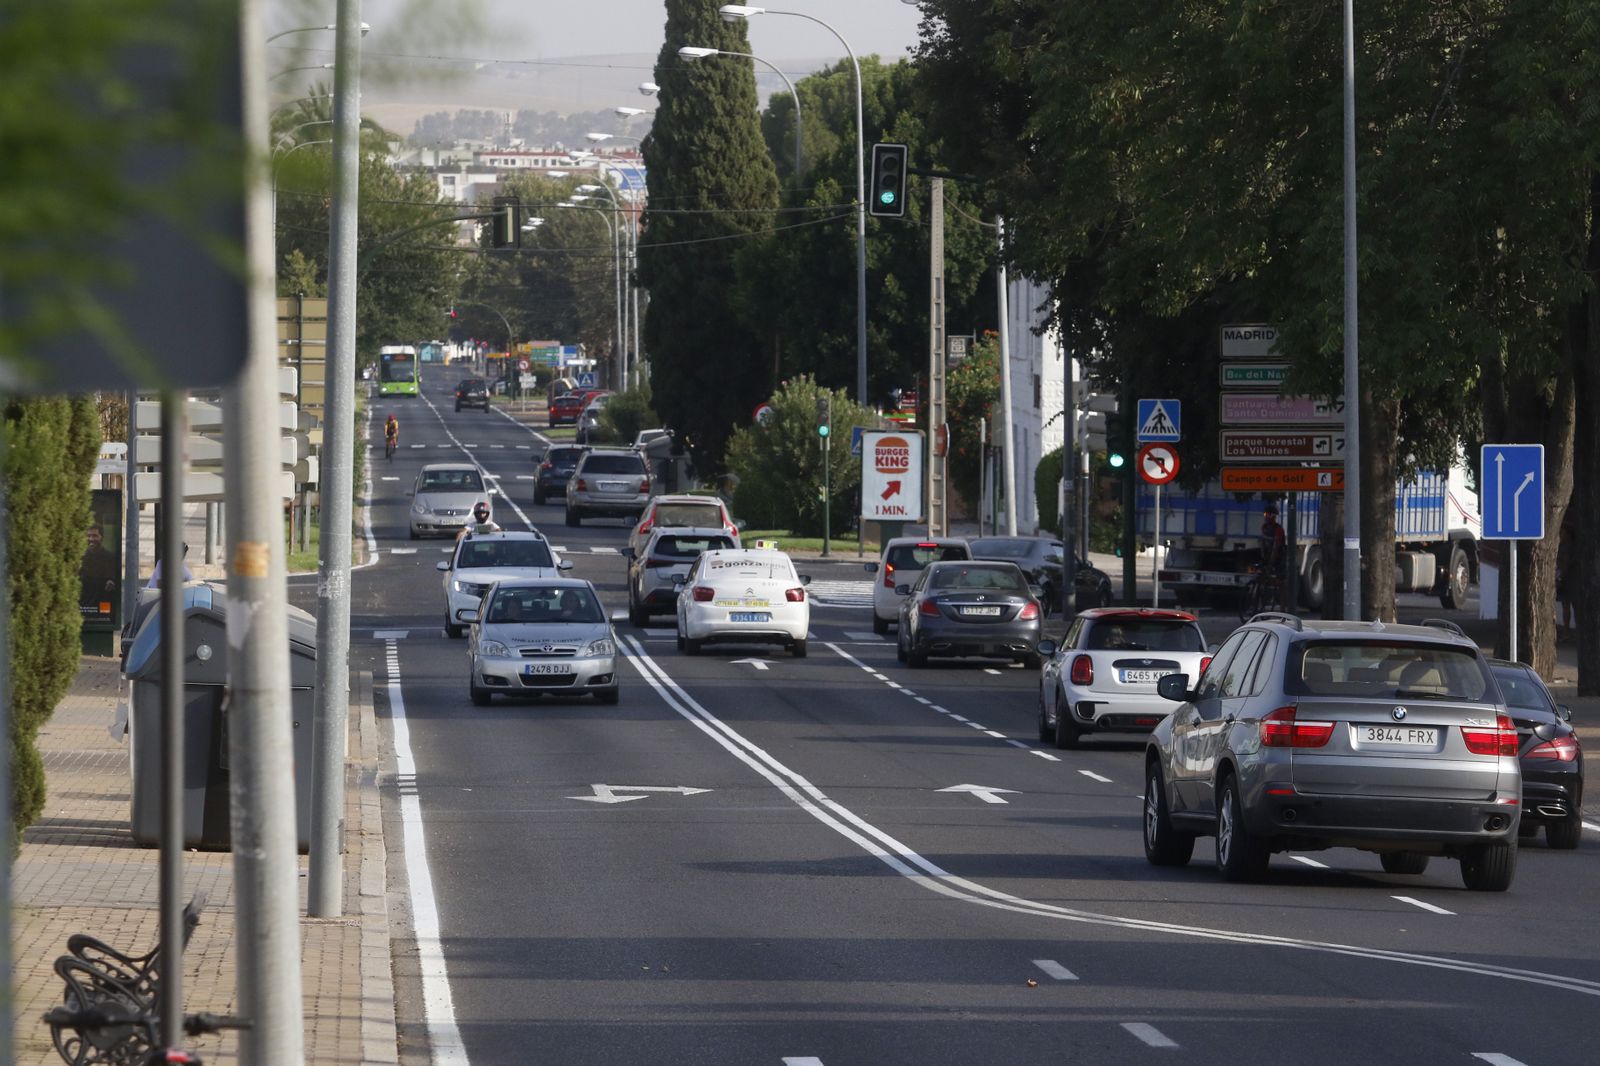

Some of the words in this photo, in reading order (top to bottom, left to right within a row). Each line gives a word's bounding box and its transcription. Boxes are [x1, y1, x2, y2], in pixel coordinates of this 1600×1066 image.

[1224, 330, 1275, 341] MADRID
[1245, 370, 1264, 380] del
[1227, 409, 1258, 418] Santo
[1260, 409, 1308, 419] Domingo
[1226, 438, 1263, 447] parque
[1266, 437, 1307, 446] forestal
[875, 448, 909, 456] BURGER
[1226, 447, 1246, 456] Los
[1249, 447, 1290, 456] Villares
[875, 456, 909, 467] KING
[1227, 474, 1261, 484] Campo
[1265, 474, 1278, 484] de
[1282, 474, 1306, 484] Golf
[881, 505, 908, 516] MIN.
[530, 665, 552, 674] 2478
[553, 665, 570, 674] DJJ
[1127, 671, 1150, 680] 6465
[1367, 727, 1403, 742] 3844
[1408, 729, 1434, 744] FRX
